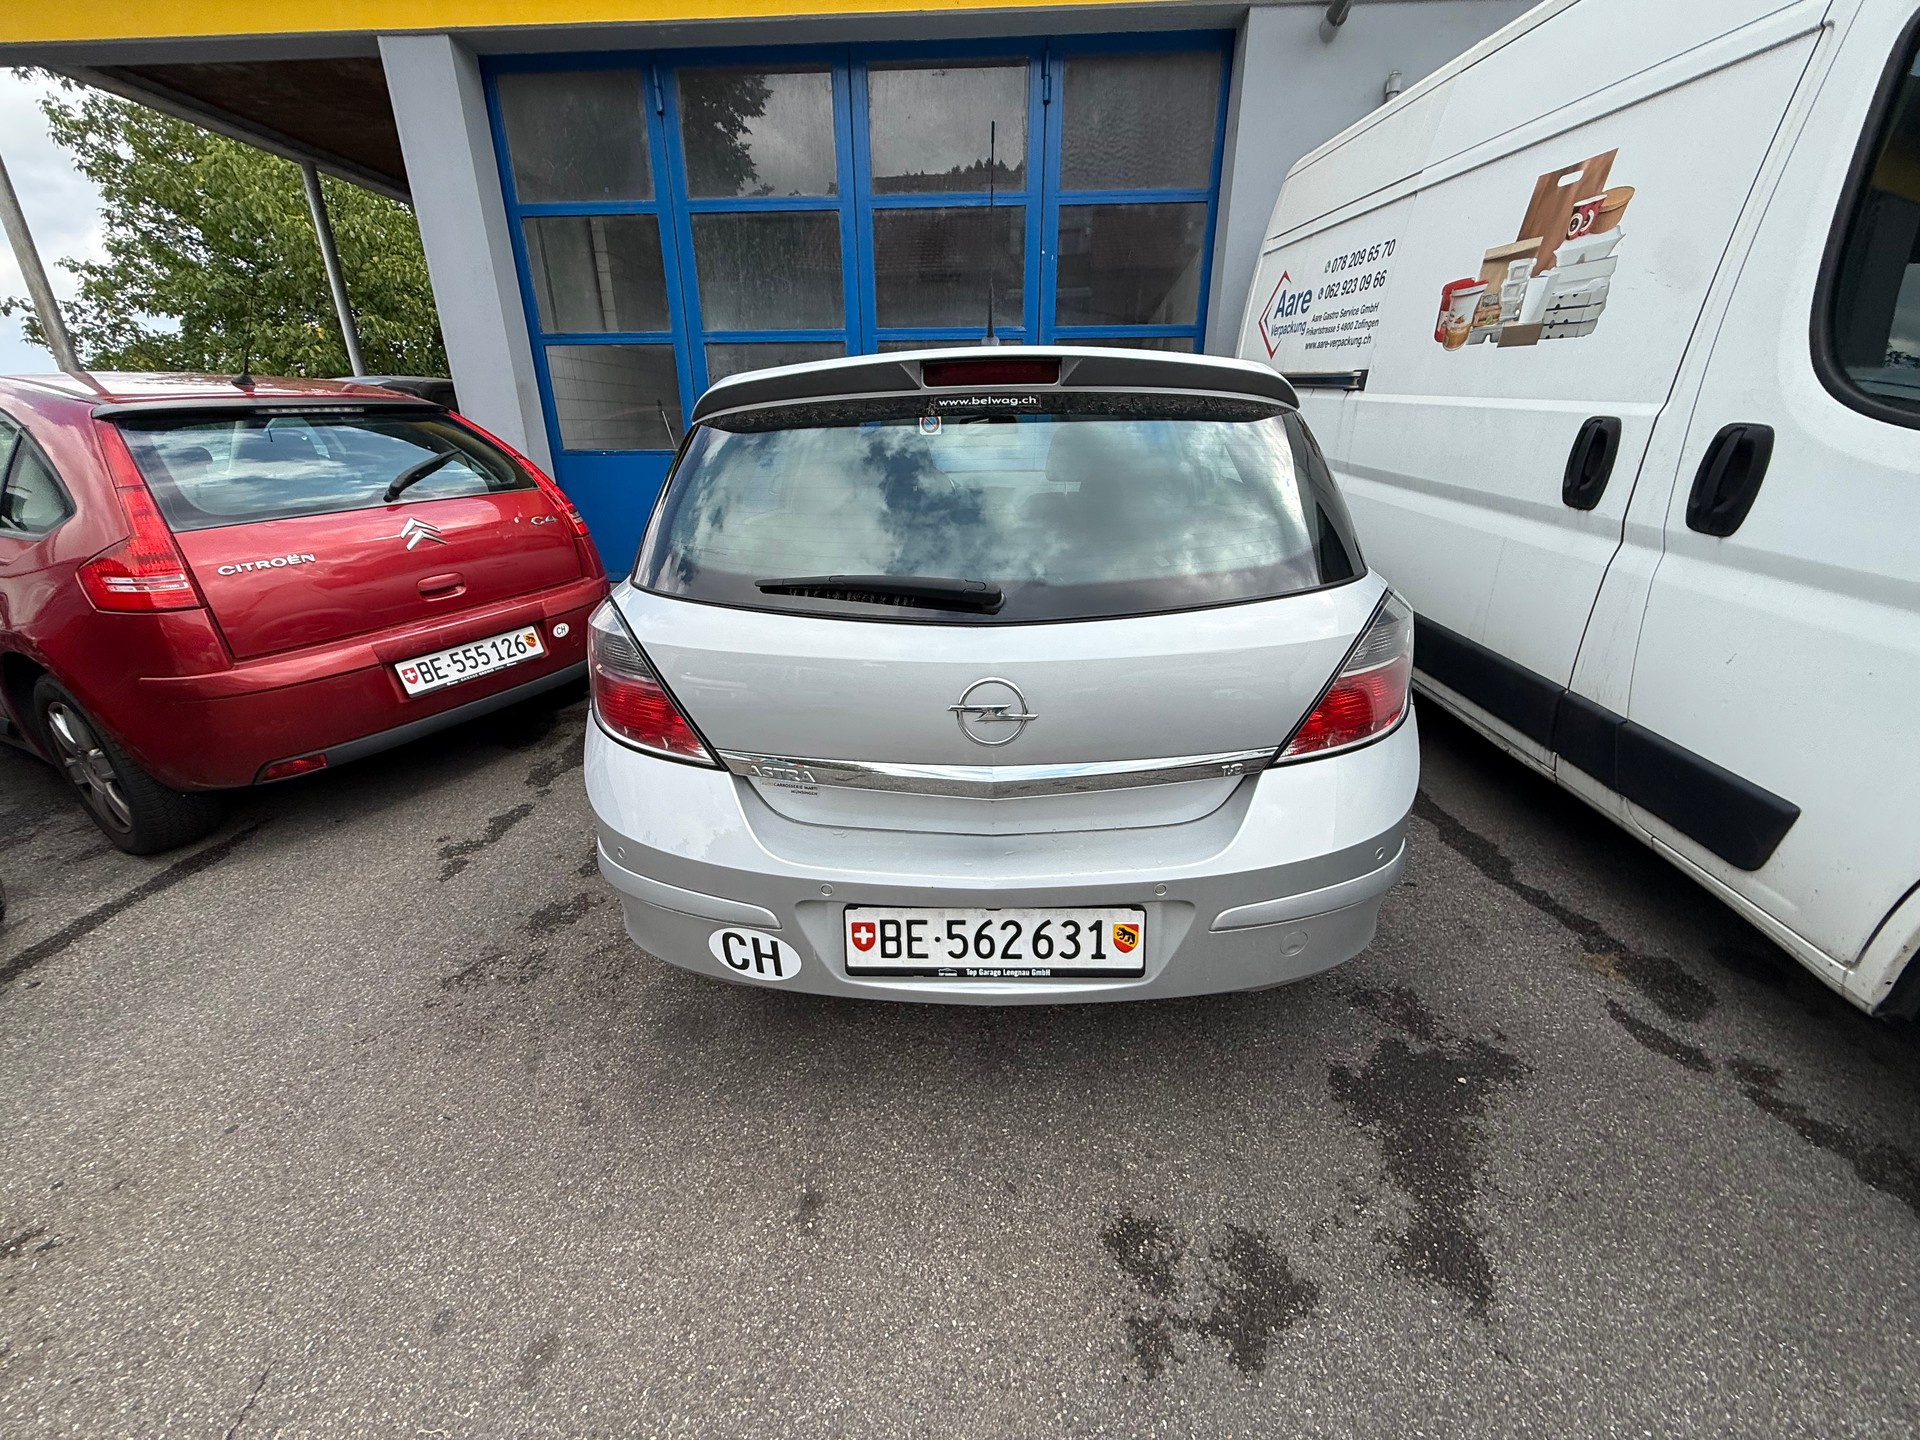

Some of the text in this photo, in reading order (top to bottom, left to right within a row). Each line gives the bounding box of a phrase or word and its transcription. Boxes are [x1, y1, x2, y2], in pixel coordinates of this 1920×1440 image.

[1331, 238, 1396, 273] 078 209 65 70
[1324, 269, 1387, 300] 062 923 09 66
[1273, 289, 1313, 319] Aare
[1311, 302, 1379, 323] Aare Gastro Service GmbH
[1270, 320, 1308, 338] Verpackung
[1341, 321, 1354, 332] 4800
[1353, 318, 1379, 331] Zofingen
[1304, 333, 1372, 350] www.aare-verpackung.ch
[939, 396, 1037, 406] www.belwag.ch
[531, 514, 558, 526] C4
[217, 554, 316, 576] CITROËN
[556, 625, 567, 635] CH
[751, 765, 816, 783] ASTRA
[722, 932, 783, 977] CH
[966, 968, 977, 977] Top
[979, 968, 1001, 977] Garage
[1003, 968, 1030, 977] Lengnau
[1031, 968, 1051, 976] GmbH
